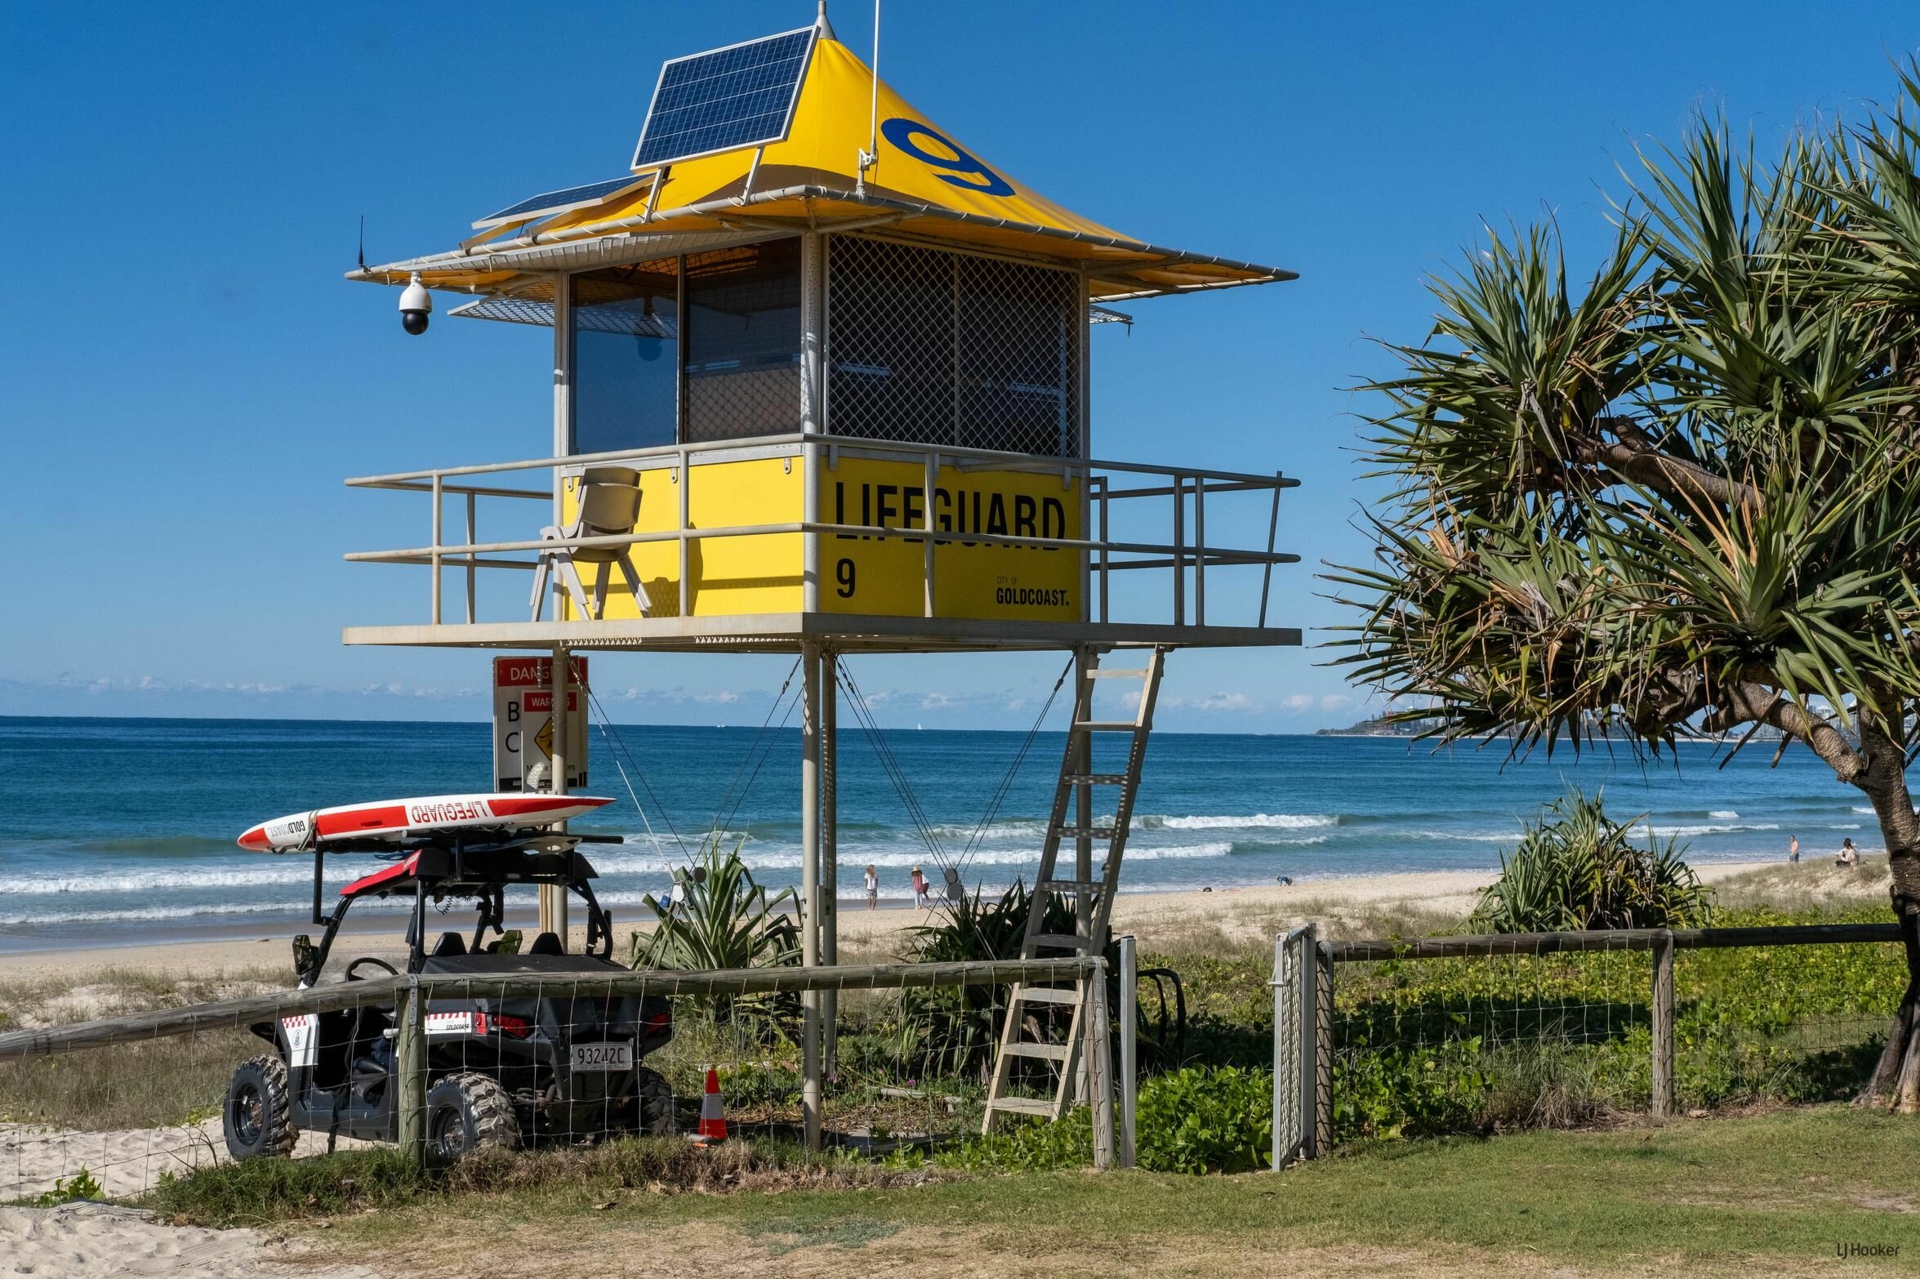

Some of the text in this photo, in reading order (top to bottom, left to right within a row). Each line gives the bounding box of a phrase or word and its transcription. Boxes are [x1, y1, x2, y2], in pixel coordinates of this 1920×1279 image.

[881, 117, 1016, 188] 9
[835, 482, 1066, 551] LIFEGUARD
[836, 558, 856, 598] 9
[411, 800, 488, 823] LIFEGUARD
[577, 1047, 625, 1065] 93242C
